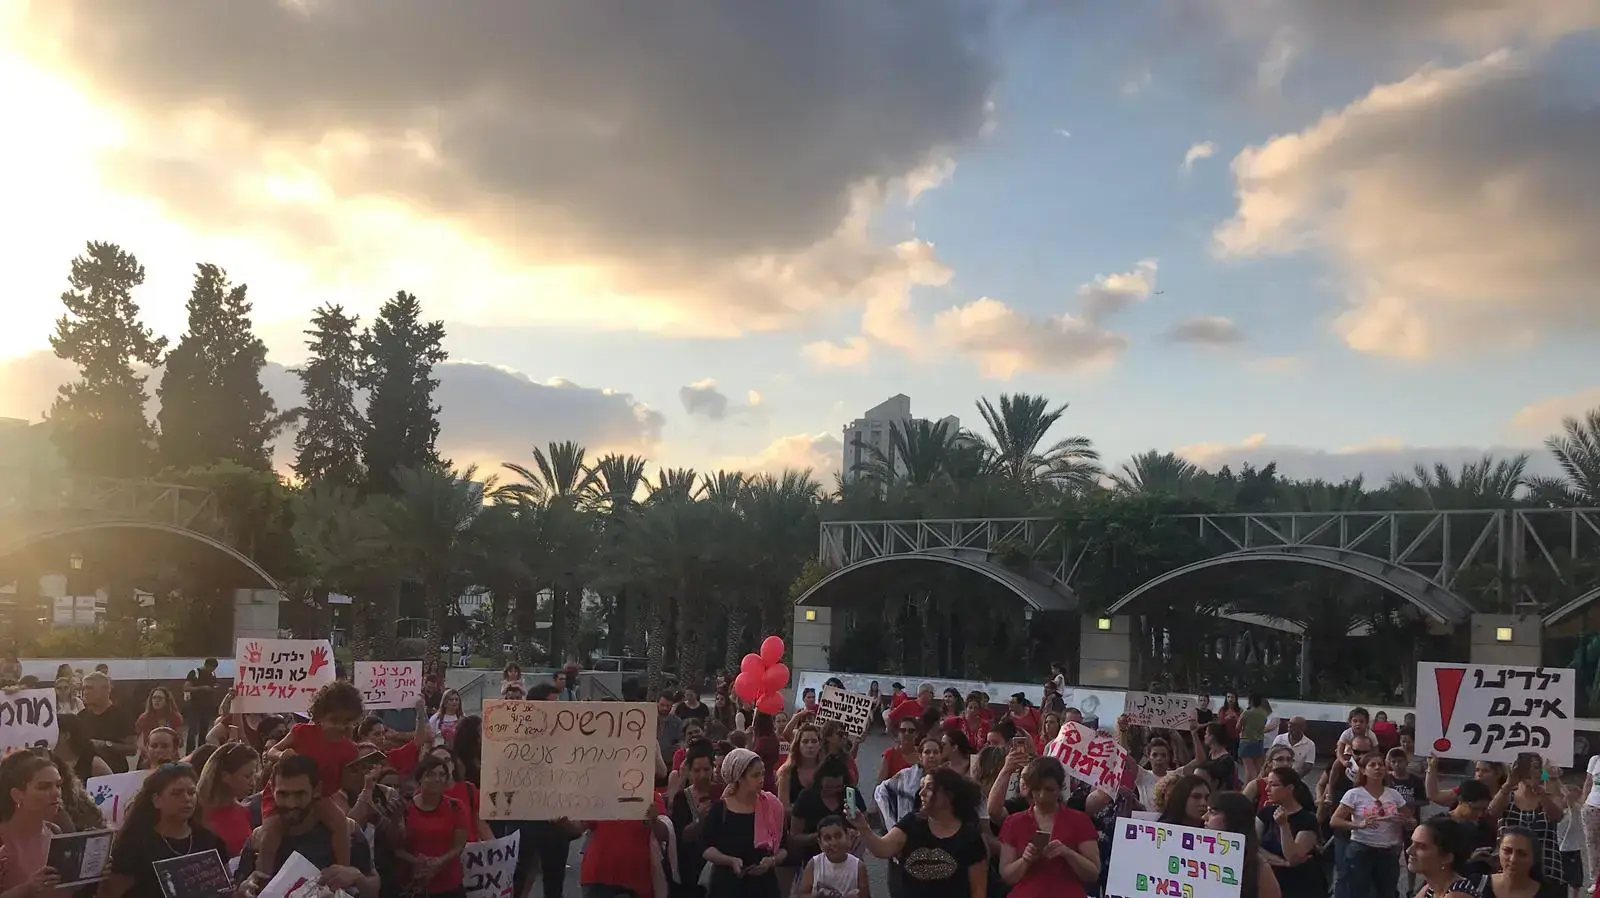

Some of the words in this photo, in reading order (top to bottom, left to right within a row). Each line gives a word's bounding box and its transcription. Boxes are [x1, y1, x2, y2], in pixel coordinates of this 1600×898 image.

[270, 651, 305, 664] ילדנו
[289, 667, 307, 682] לא
[370, 679, 386, 689] אני
[394, 679, 416, 689] אותי
[1474, 667, 1561, 690] ילדינו
[363, 689, 386, 701] ילד
[834, 691, 871, 708] מאחורי
[855, 706, 869, 718] כל
[1488, 697, 1567, 719] אינם
[550, 708, 646, 740] דורשים
[1463, 721, 1551, 754] הפקר
[503, 743, 558, 765] ענישה
[566, 744, 648, 764] החמרת
[1125, 823, 1173, 849] יקרים
[1182, 832, 1240, 855] ילדים
[467, 840, 516, 869] אמא
[1168, 855, 1239, 885] ברוכים
[1136, 873, 1194, 898] הבאים
